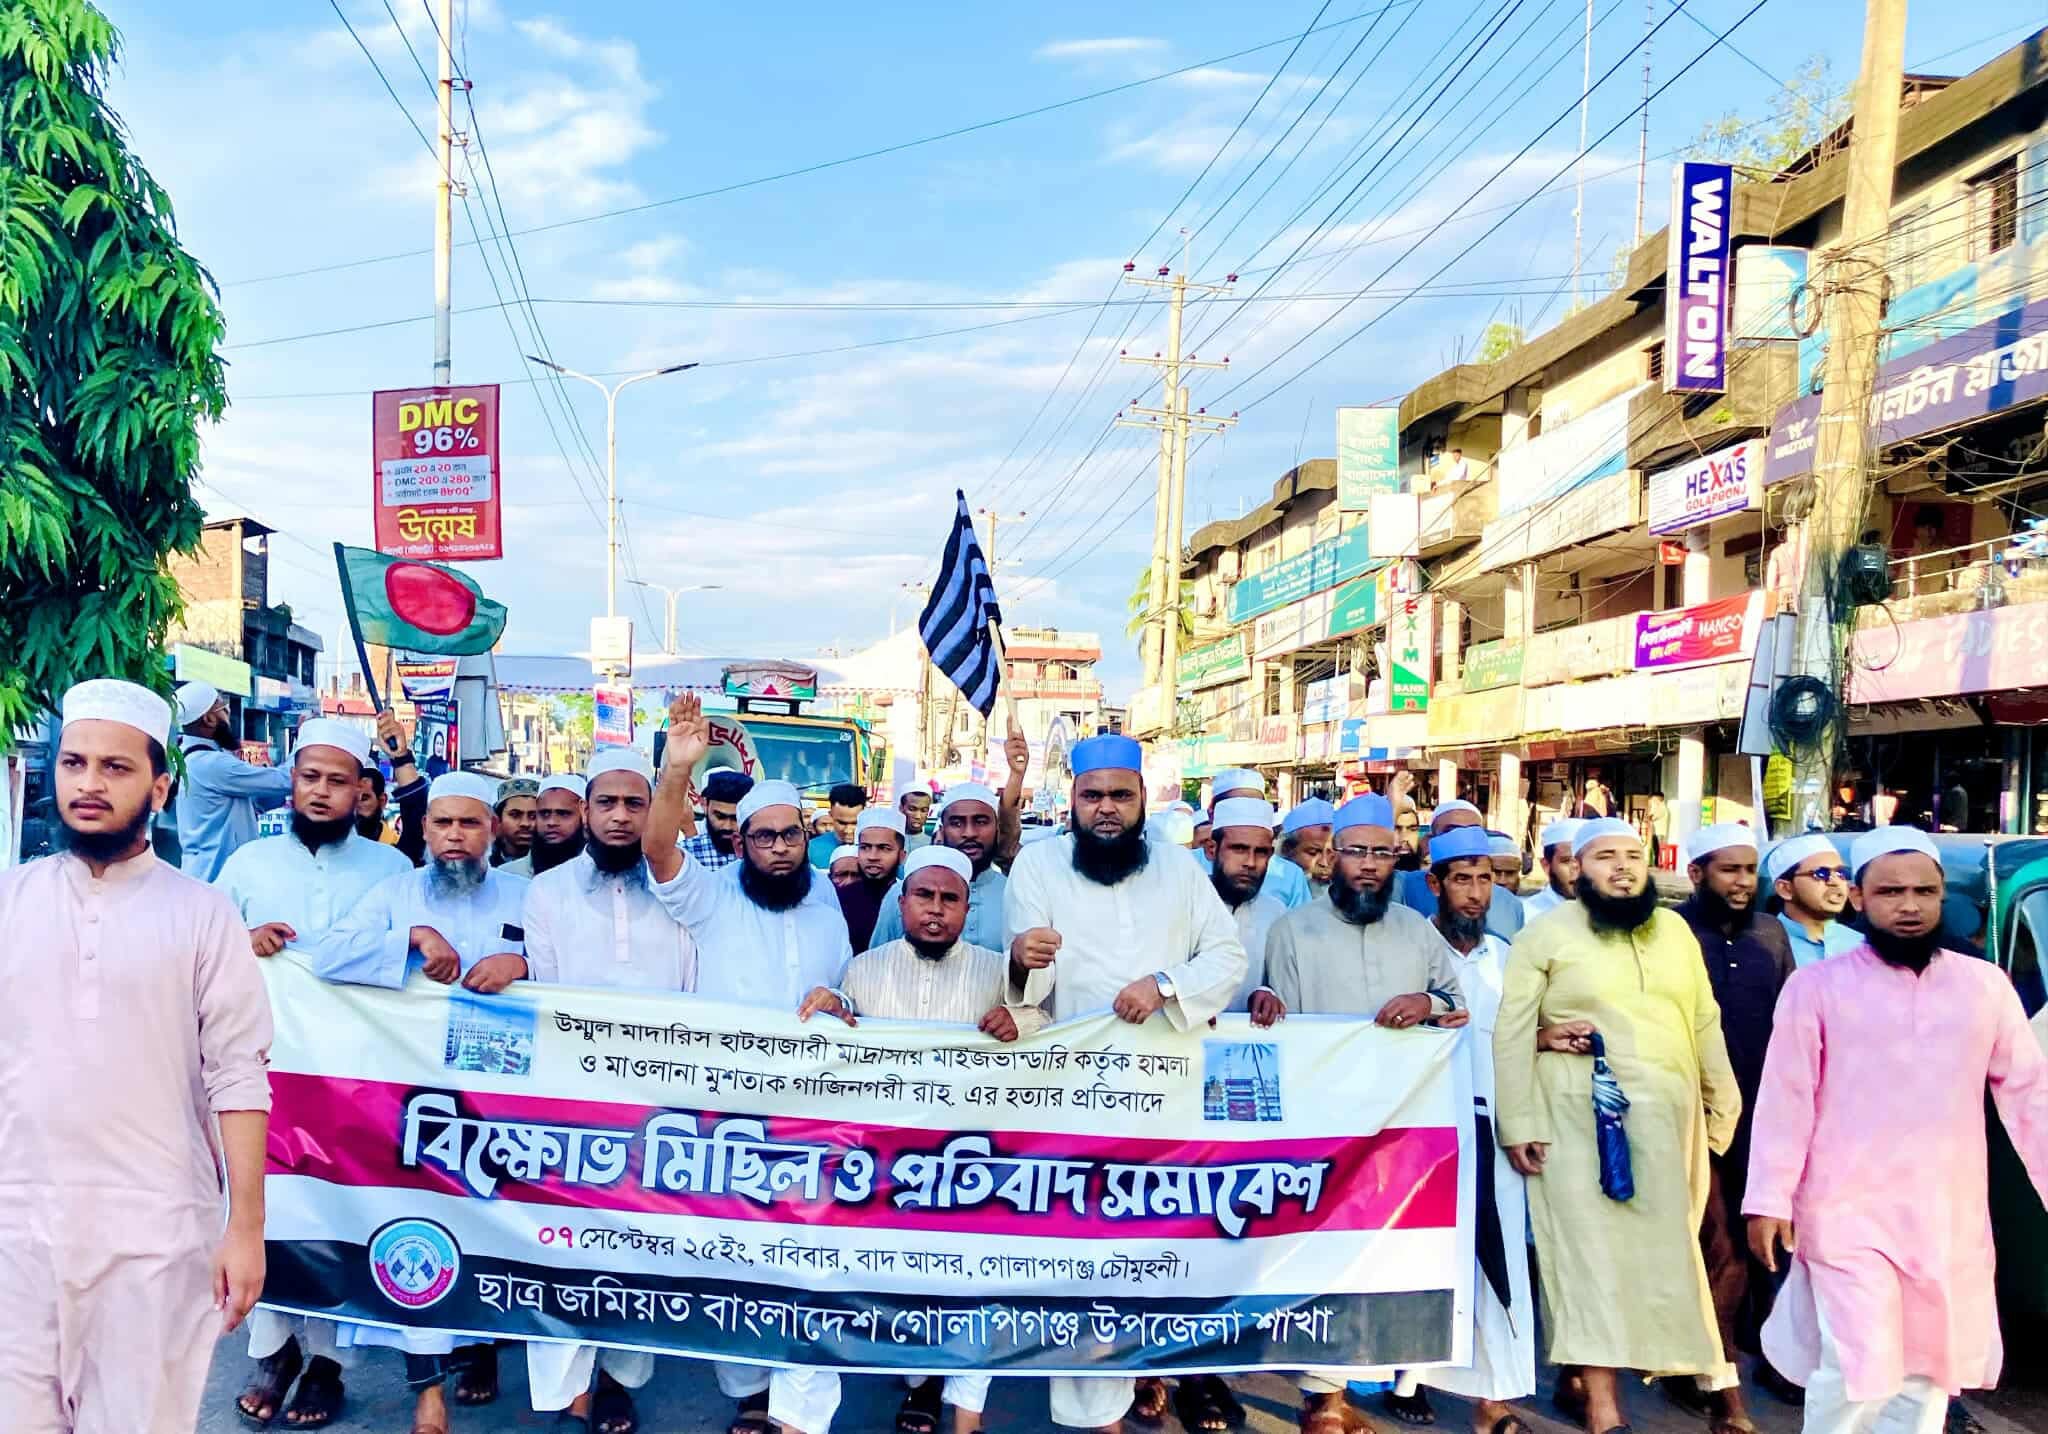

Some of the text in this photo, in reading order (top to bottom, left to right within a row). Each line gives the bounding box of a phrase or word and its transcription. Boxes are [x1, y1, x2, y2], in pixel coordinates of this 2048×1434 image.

[1685, 177, 1723, 379] WALTON
[399, 398, 479, 432] DMC
[414, 427, 479, 454] 96%
[394, 477, 417, 487] DMC
[397, 508, 477, 543] উন্মেষ
[1403, 599, 1420, 662] EXIM
[620, 1021, 711, 1049] মাদারিস
[720, 1029, 831, 1062] হাটহাজারী
[1074, 1044, 1132, 1081] কর্তৃক
[1136, 1052, 1192, 1078] হামলা
[579, 1055, 597, 1073] ও
[604, 1053, 699, 1086] মাওলানা
[704, 1065, 788, 1096] মুশতাক
[793, 1071, 906, 1100] গাজিনগরী
[964, 1085, 1001, 1107] এর
[1006, 1085, 1064, 1108] হত্যার
[1072, 1082, 1168, 1113] প্রতিবাদে
[402, 1093, 1330, 1238] বিক্ষোভ মিছিল ও প্রতিবাদ সমাবেশ
[538, 1226, 573, 1249] ০৭
[580, 1226, 676, 1257] সেপ্টেম্বর
[760, 1237, 849, 1274] রবিবার,
[854, 1247, 897, 1272] বাদ
[902, 1250, 972, 1280] আসর,
[980, 1253, 1095, 1281] গোলাপগঞ্জ
[473, 1272, 548, 1313] ছাত্র
[552, 1275, 696, 1323] জমিয়ত
[700, 1292, 882, 1346] বাংলাদেশ
[891, 1304, 1080, 1348] গোলাপগঞ্জ
[1088, 1301, 1244, 1347] উপজেলা
[1250, 1305, 1335, 1345] শাখা
